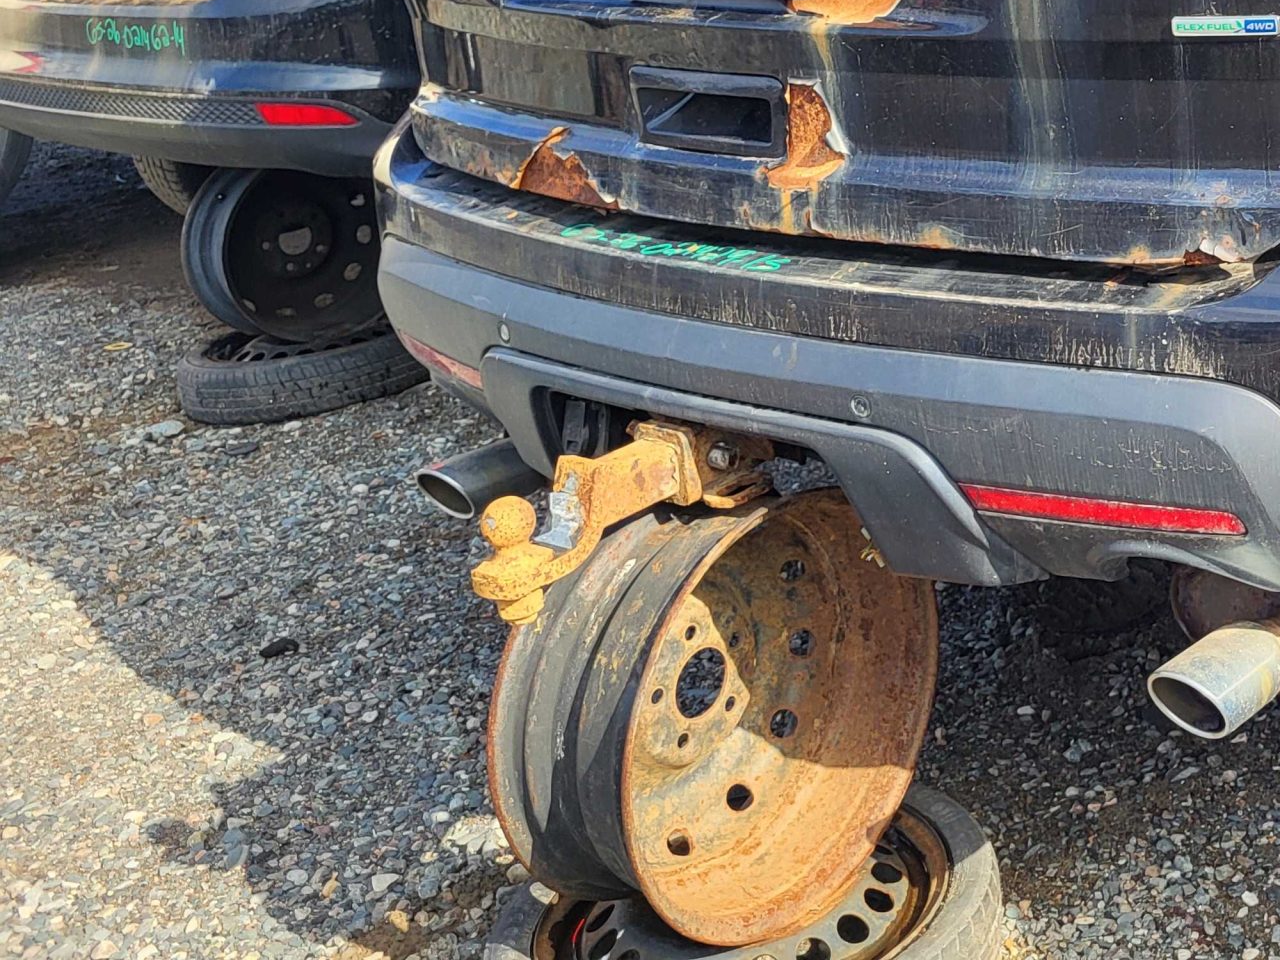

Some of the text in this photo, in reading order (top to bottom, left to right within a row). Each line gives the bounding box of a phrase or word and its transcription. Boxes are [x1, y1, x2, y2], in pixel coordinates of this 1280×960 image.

[1176, 22, 1275, 31] FLEX FUEL 4WD
